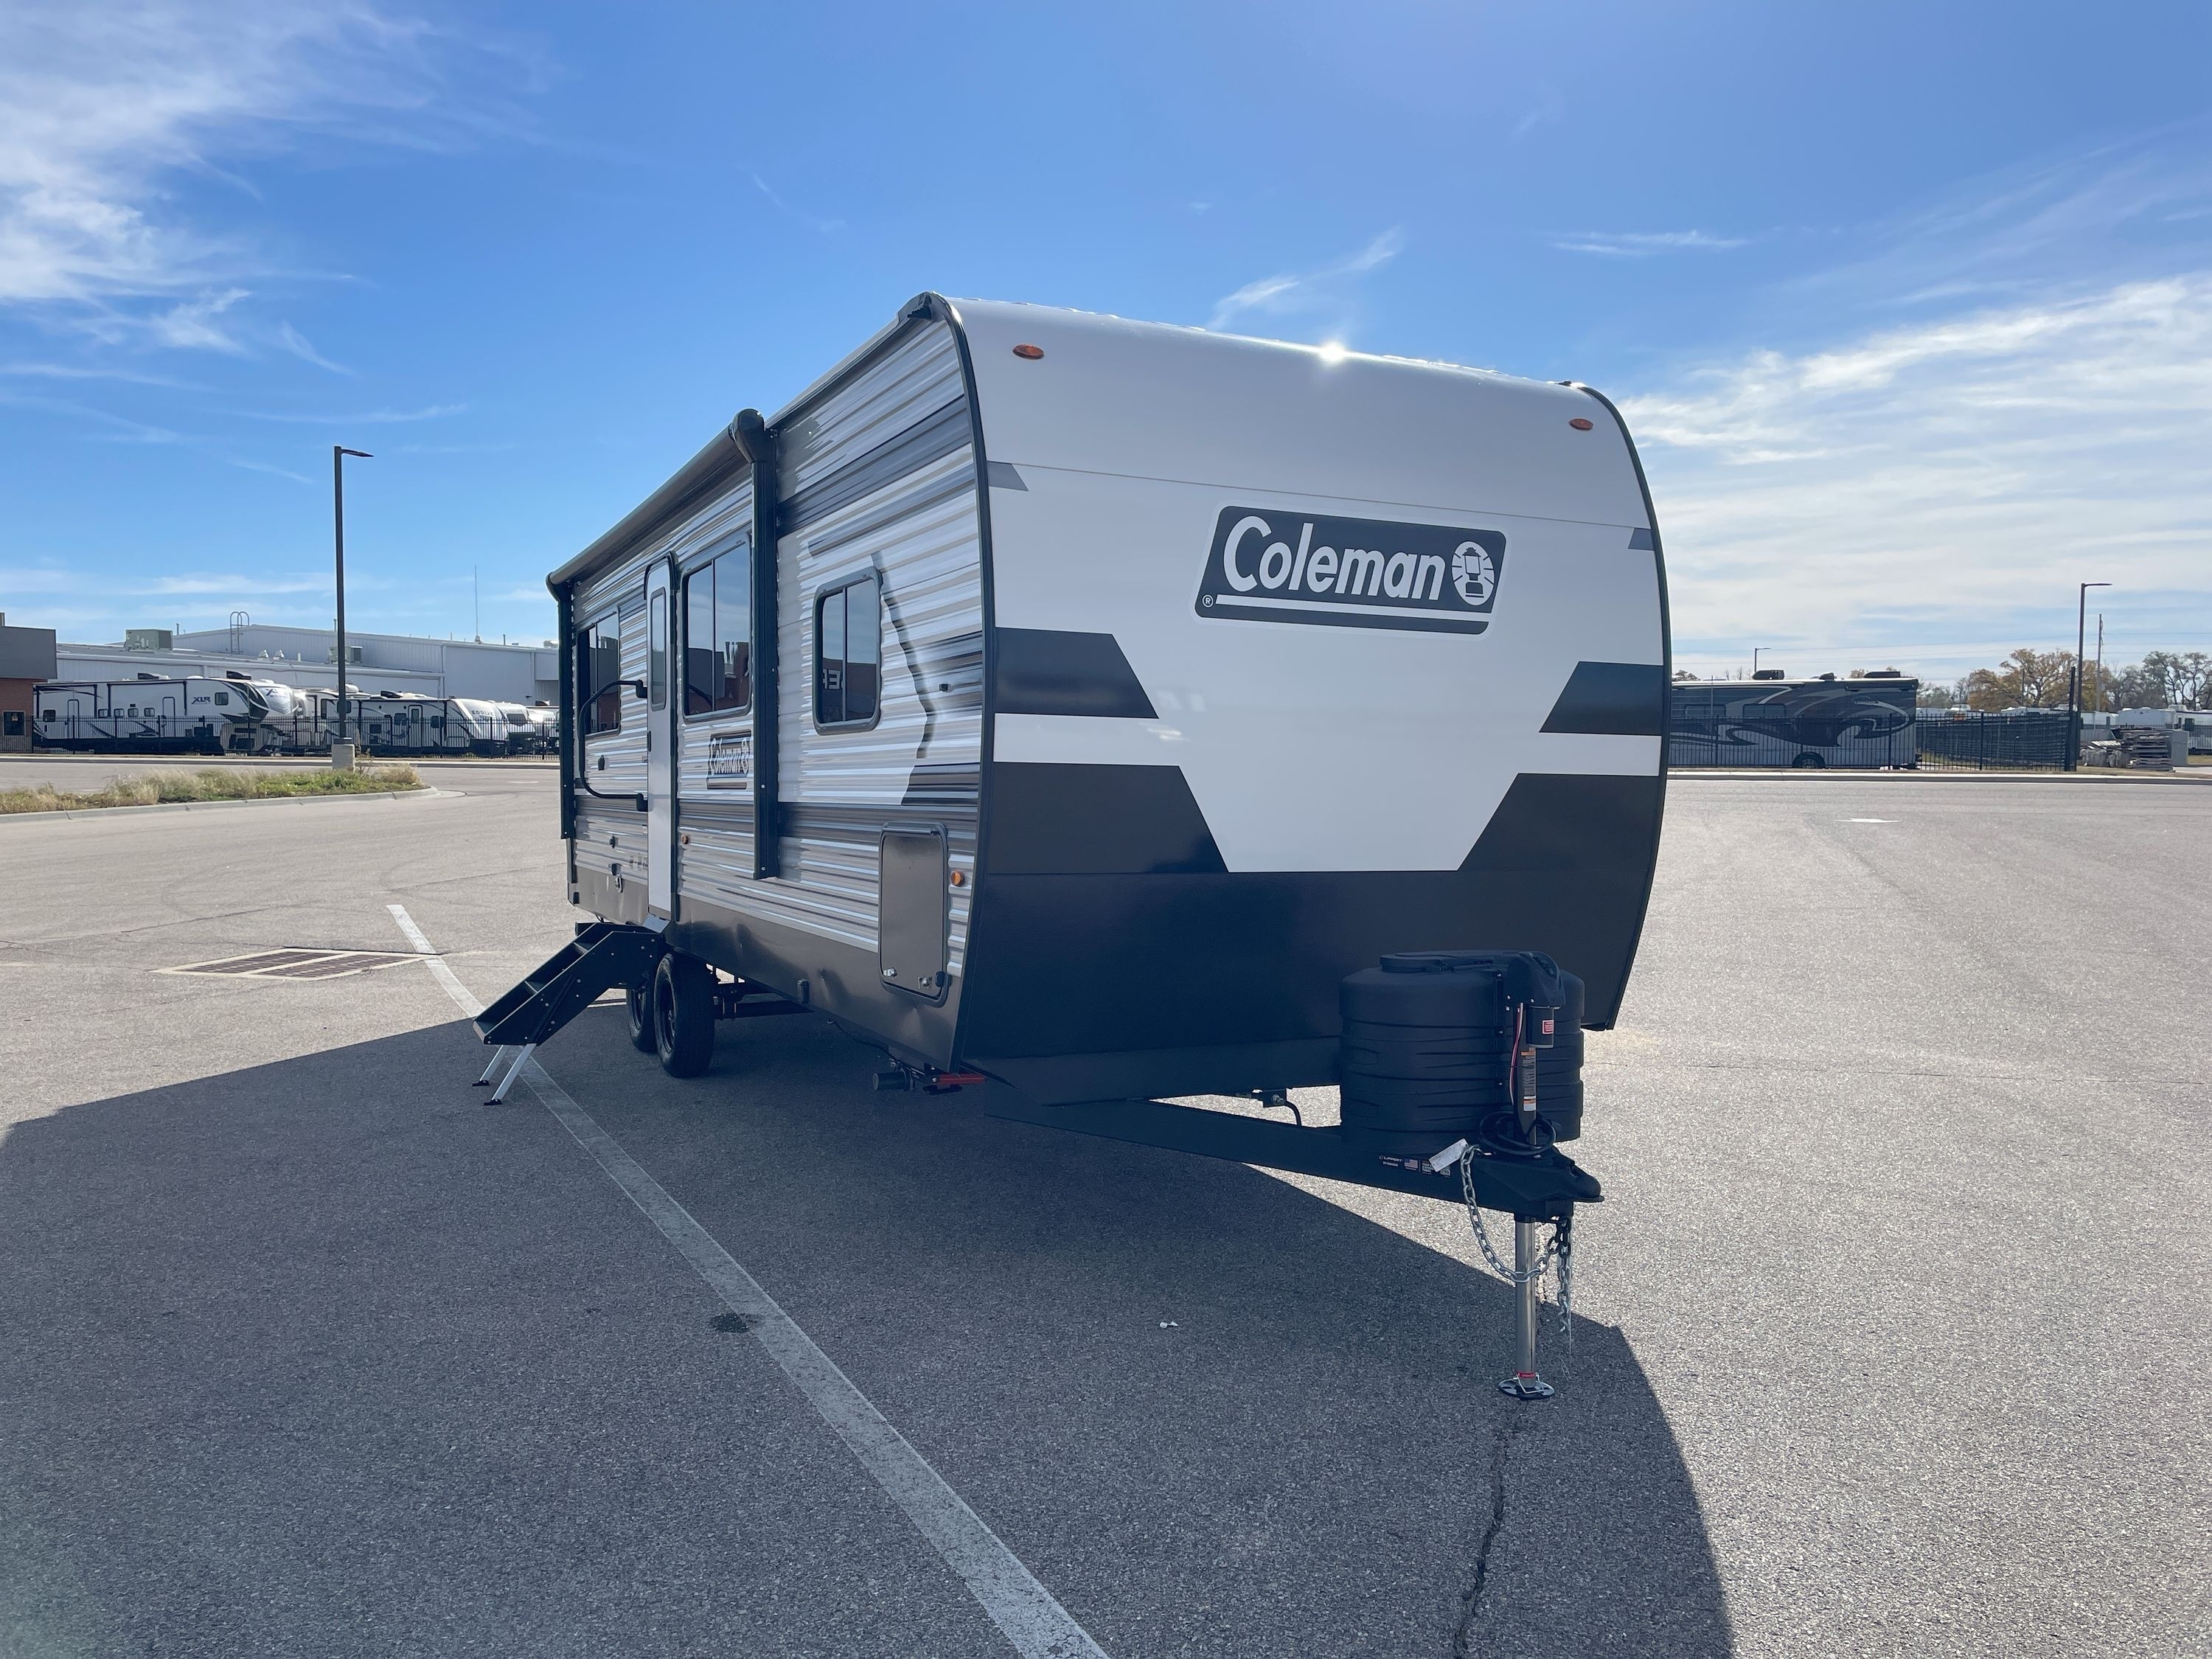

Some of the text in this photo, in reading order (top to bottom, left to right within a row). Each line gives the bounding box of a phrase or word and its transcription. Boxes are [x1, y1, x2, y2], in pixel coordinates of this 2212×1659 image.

[1223, 515, 1446, 601] Coleman
[191, 696, 212, 704] XLR
[709, 737, 742, 776] Coleman
